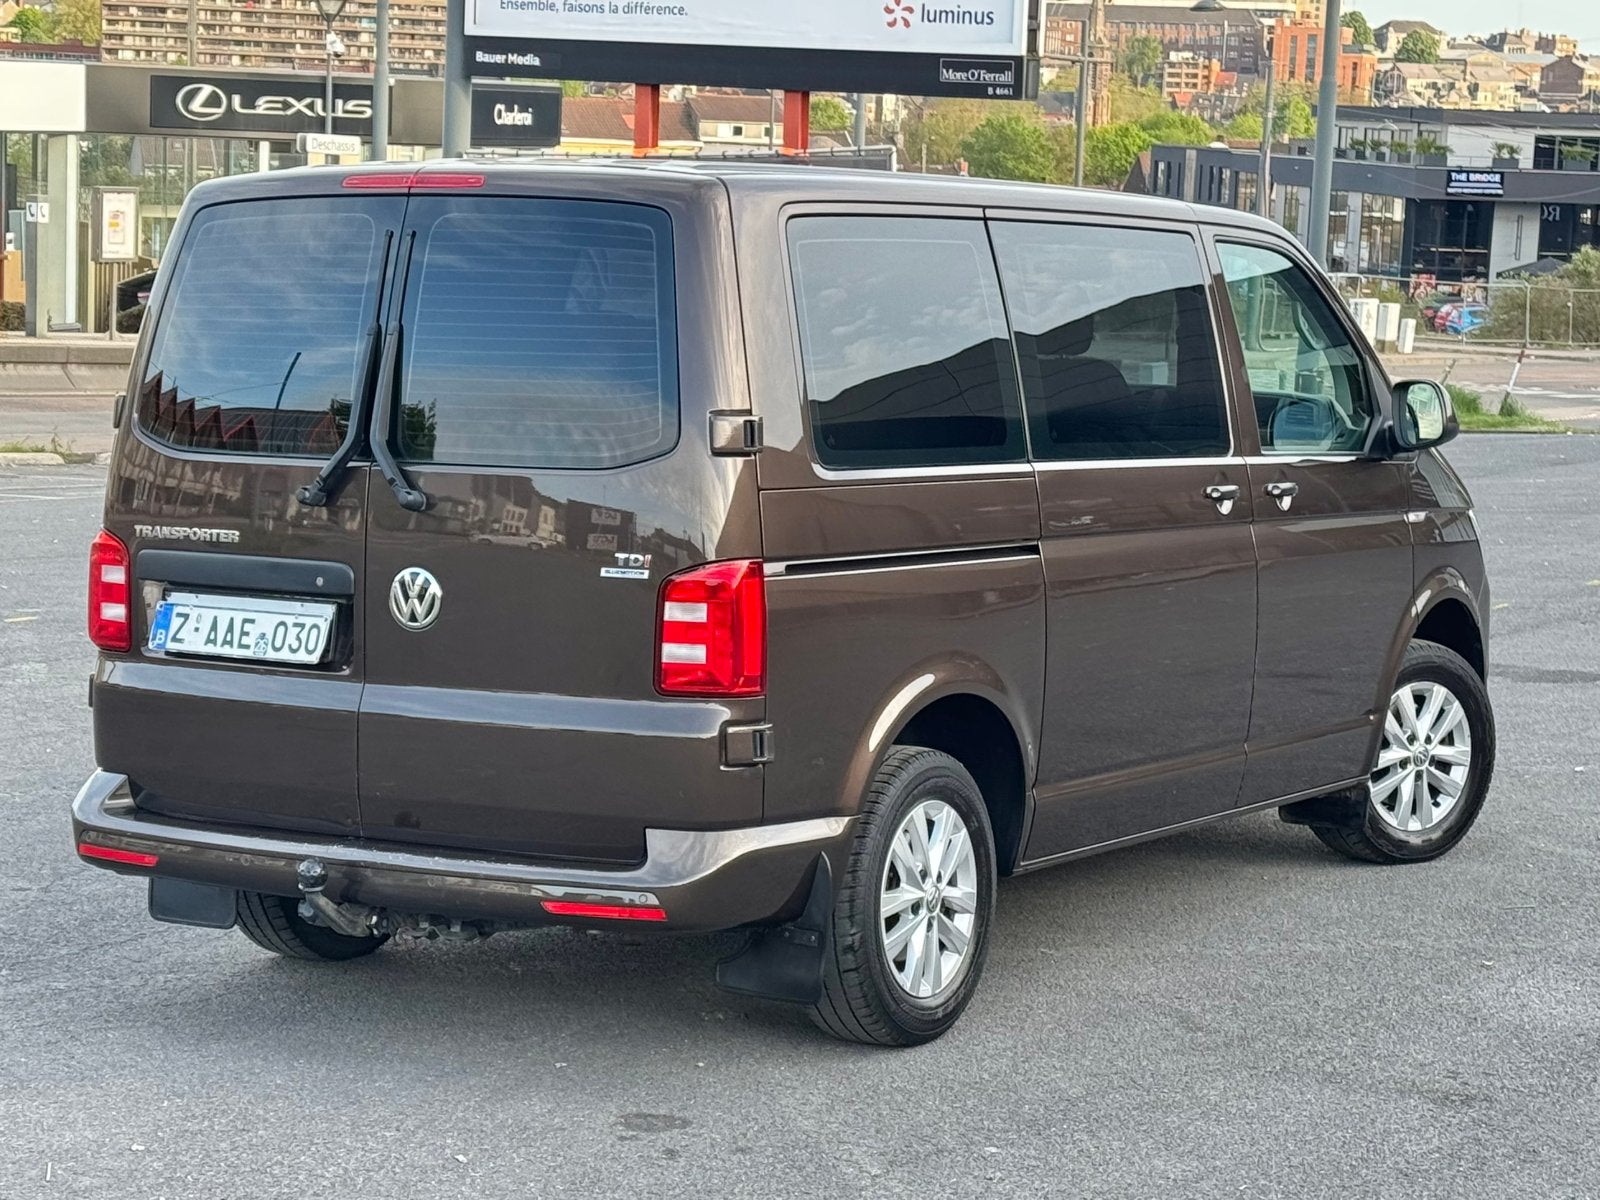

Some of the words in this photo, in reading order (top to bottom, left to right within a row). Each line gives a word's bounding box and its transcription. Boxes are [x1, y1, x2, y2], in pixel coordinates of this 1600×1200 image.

[563, 1, 605, 14] faisons
[608, 2, 618, 14] la
[622, 2, 688, 16] différence.
[920, 3, 994, 25] luminus
[475, 50, 507, 64] Bauer
[507, 53, 541, 67] Media
[942, 68, 968, 80] More
[968, 69, 1012, 82] O'Ferrall
[231, 94, 373, 119] LEXUS
[1469, 173, 1501, 183] BRIDGE
[134, 524, 240, 543] TRANSPORTER
